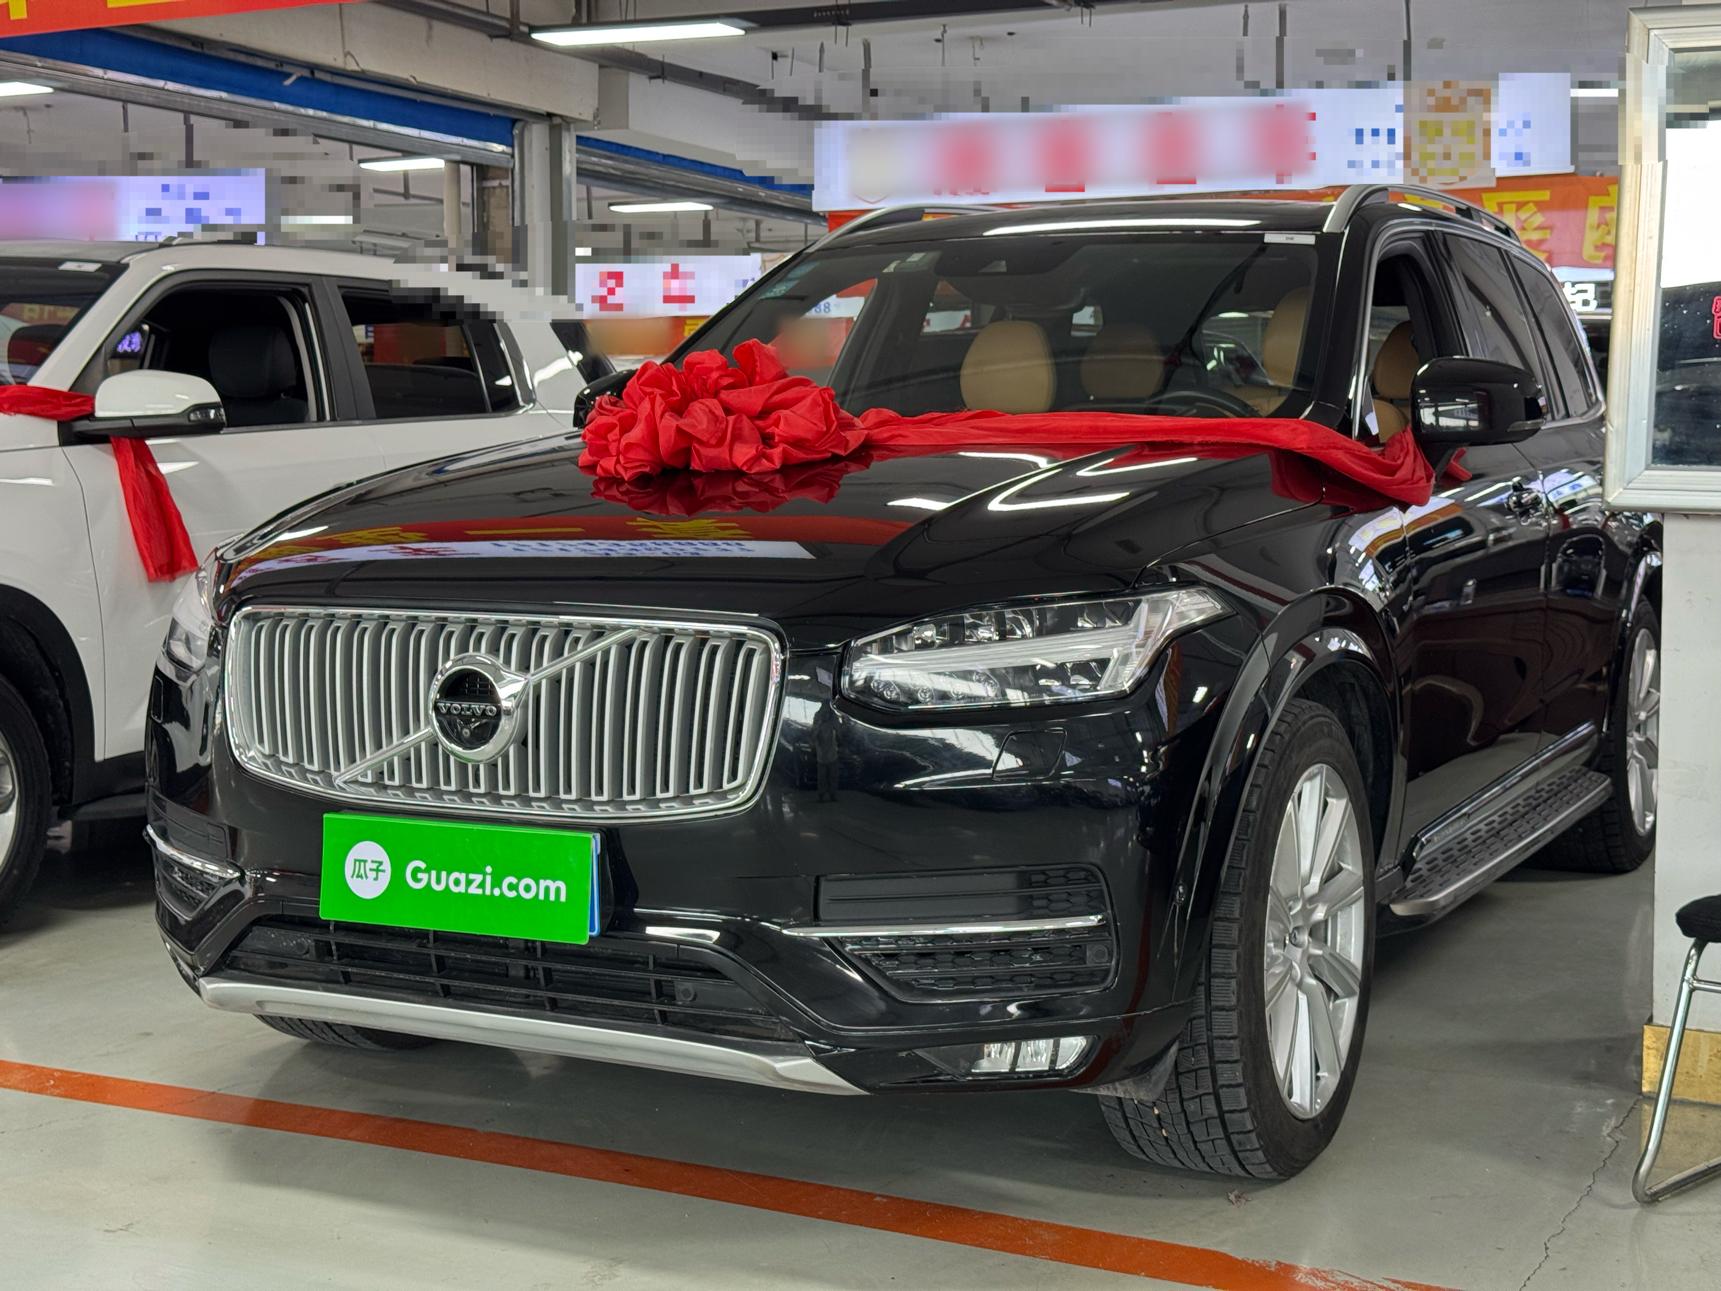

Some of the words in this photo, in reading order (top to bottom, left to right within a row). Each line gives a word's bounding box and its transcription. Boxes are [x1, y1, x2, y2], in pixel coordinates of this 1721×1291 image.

[437, 702, 497, 716] VOLVO
[350, 858, 386, 881] 瓜子
[405, 860, 567, 902] Guazi.com
